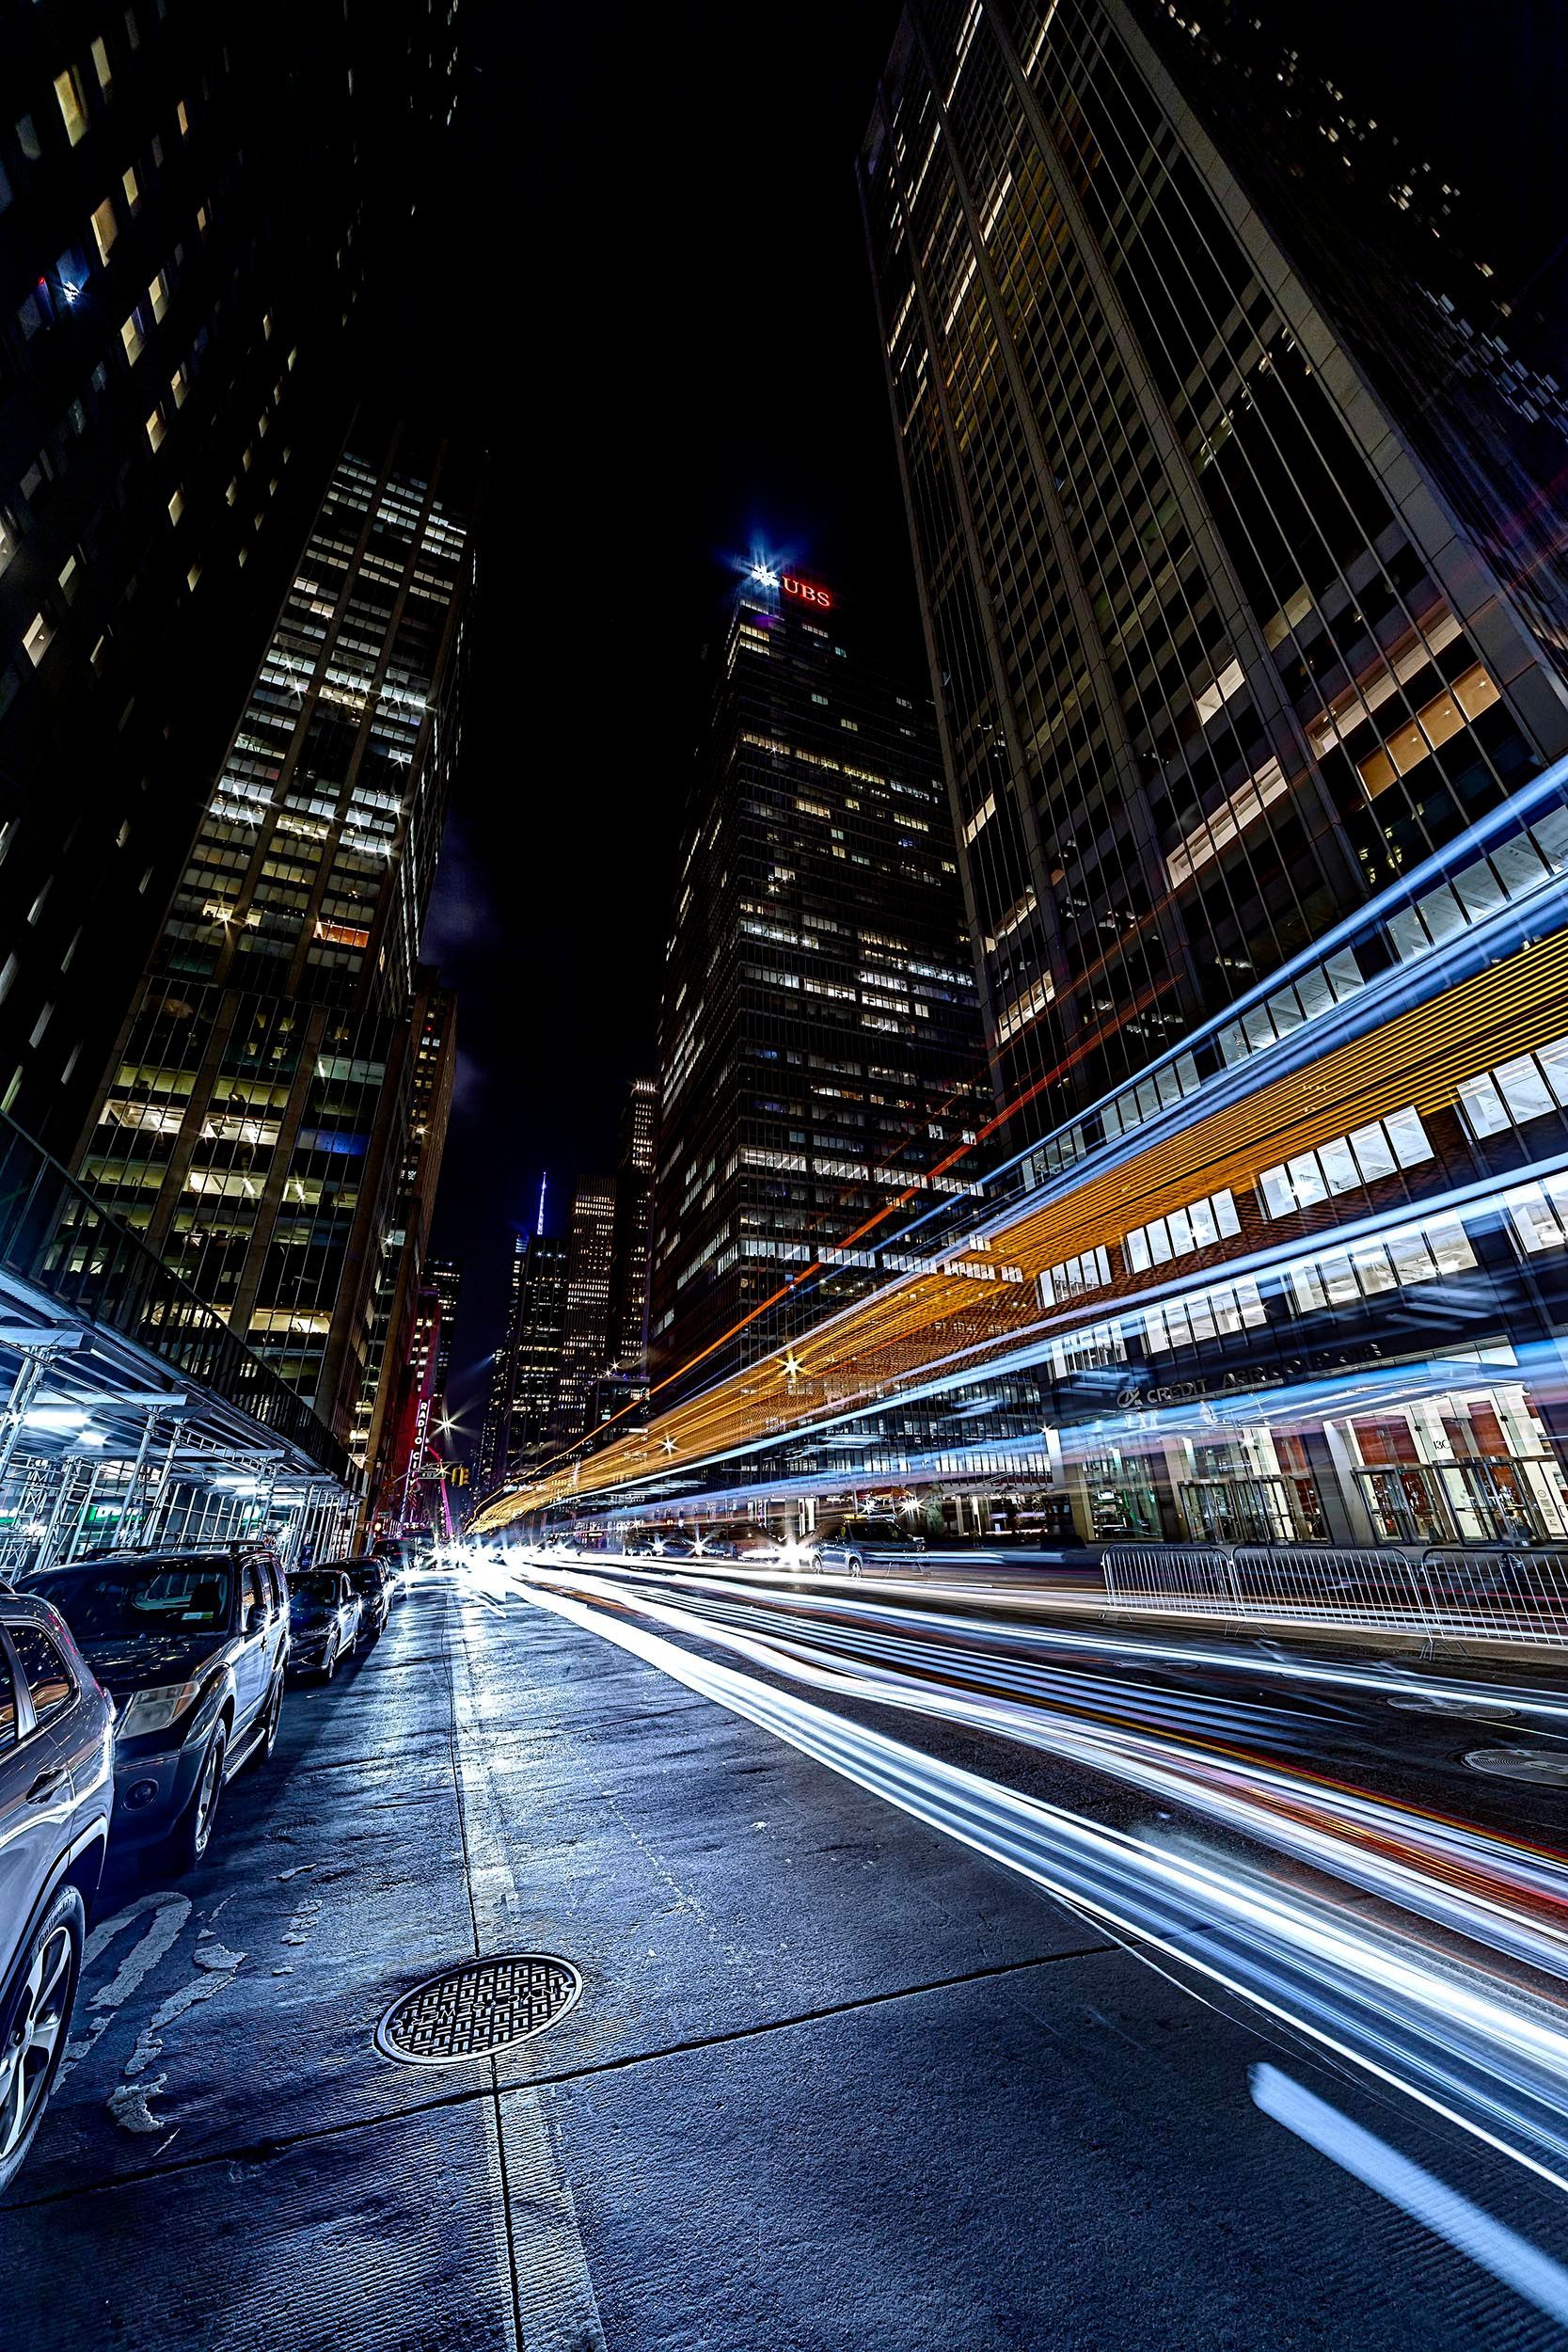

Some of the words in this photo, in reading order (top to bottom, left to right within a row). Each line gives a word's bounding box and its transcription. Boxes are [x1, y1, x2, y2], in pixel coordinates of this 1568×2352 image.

[782, 575, 831, 607] UBS
[414, 1402, 428, 1444] RADIO
[411, 2002, 485, 2026] SEWER
